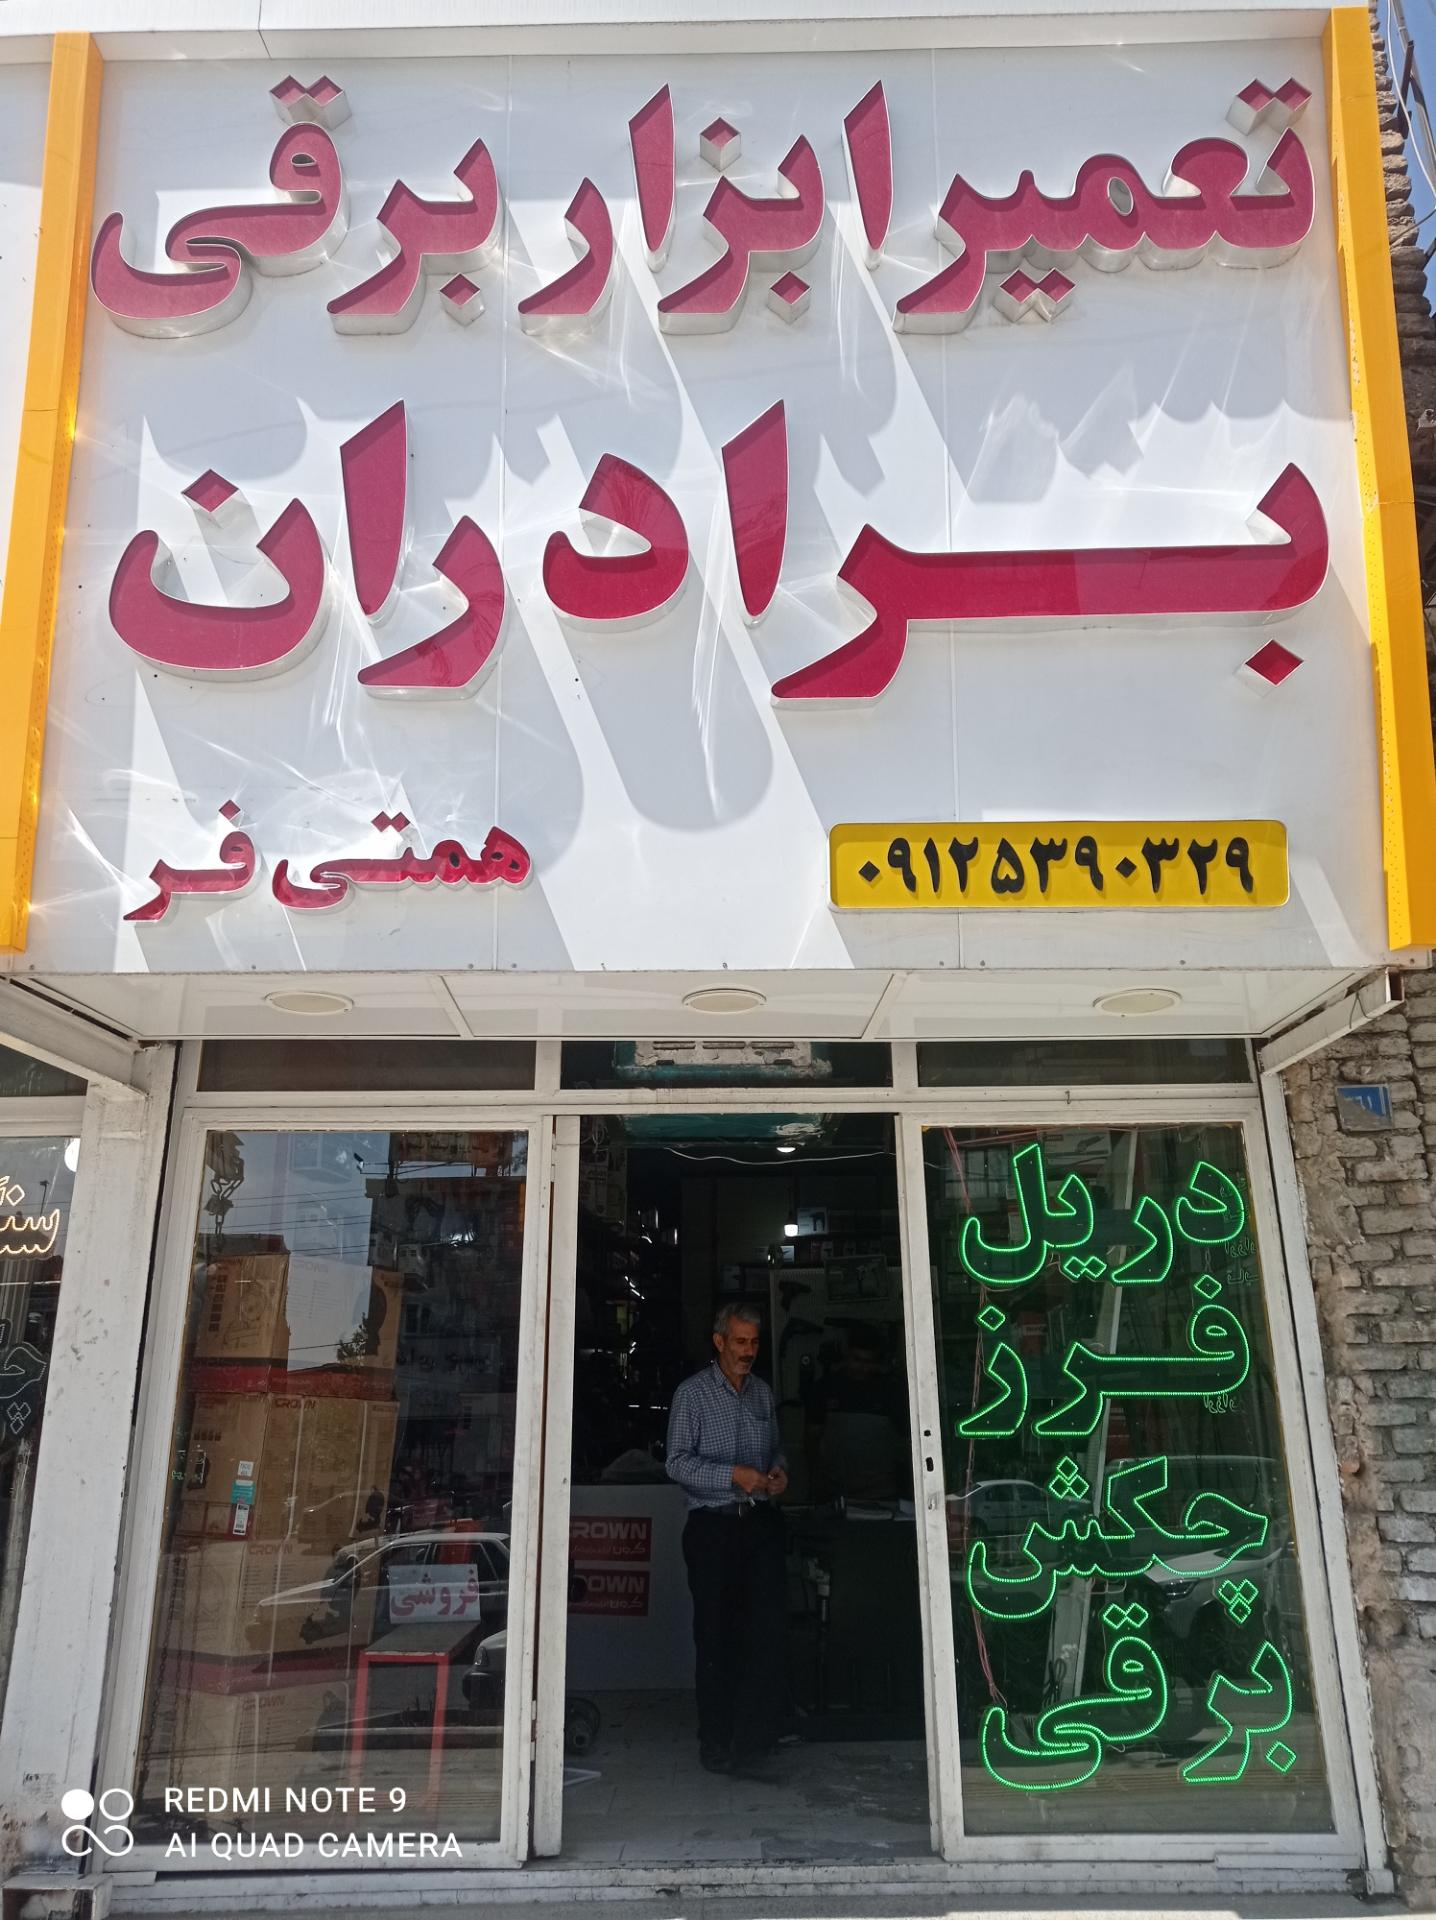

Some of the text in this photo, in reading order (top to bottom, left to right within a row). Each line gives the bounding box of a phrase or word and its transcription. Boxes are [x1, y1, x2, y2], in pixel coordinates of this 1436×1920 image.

[91, 75, 1315, 319] تعمیر ابزار برقی
[108, 400, 1328, 699] برادران
[858, 835, 1253, 895] ۰۹۱۲۵۳۹۰۳۲۹
[961, 1144, 1245, 1284] دریل
[956, 1275, 1250, 1436] فرز
[391, 1569, 479, 1616] فروشی
[571, 1521, 647, 1540] ROWN
[574, 1575, 645, 1594] OWN
[968, 1456, 1268, 1623] چکش
[981, 1602, 1296, 1790] برقی
